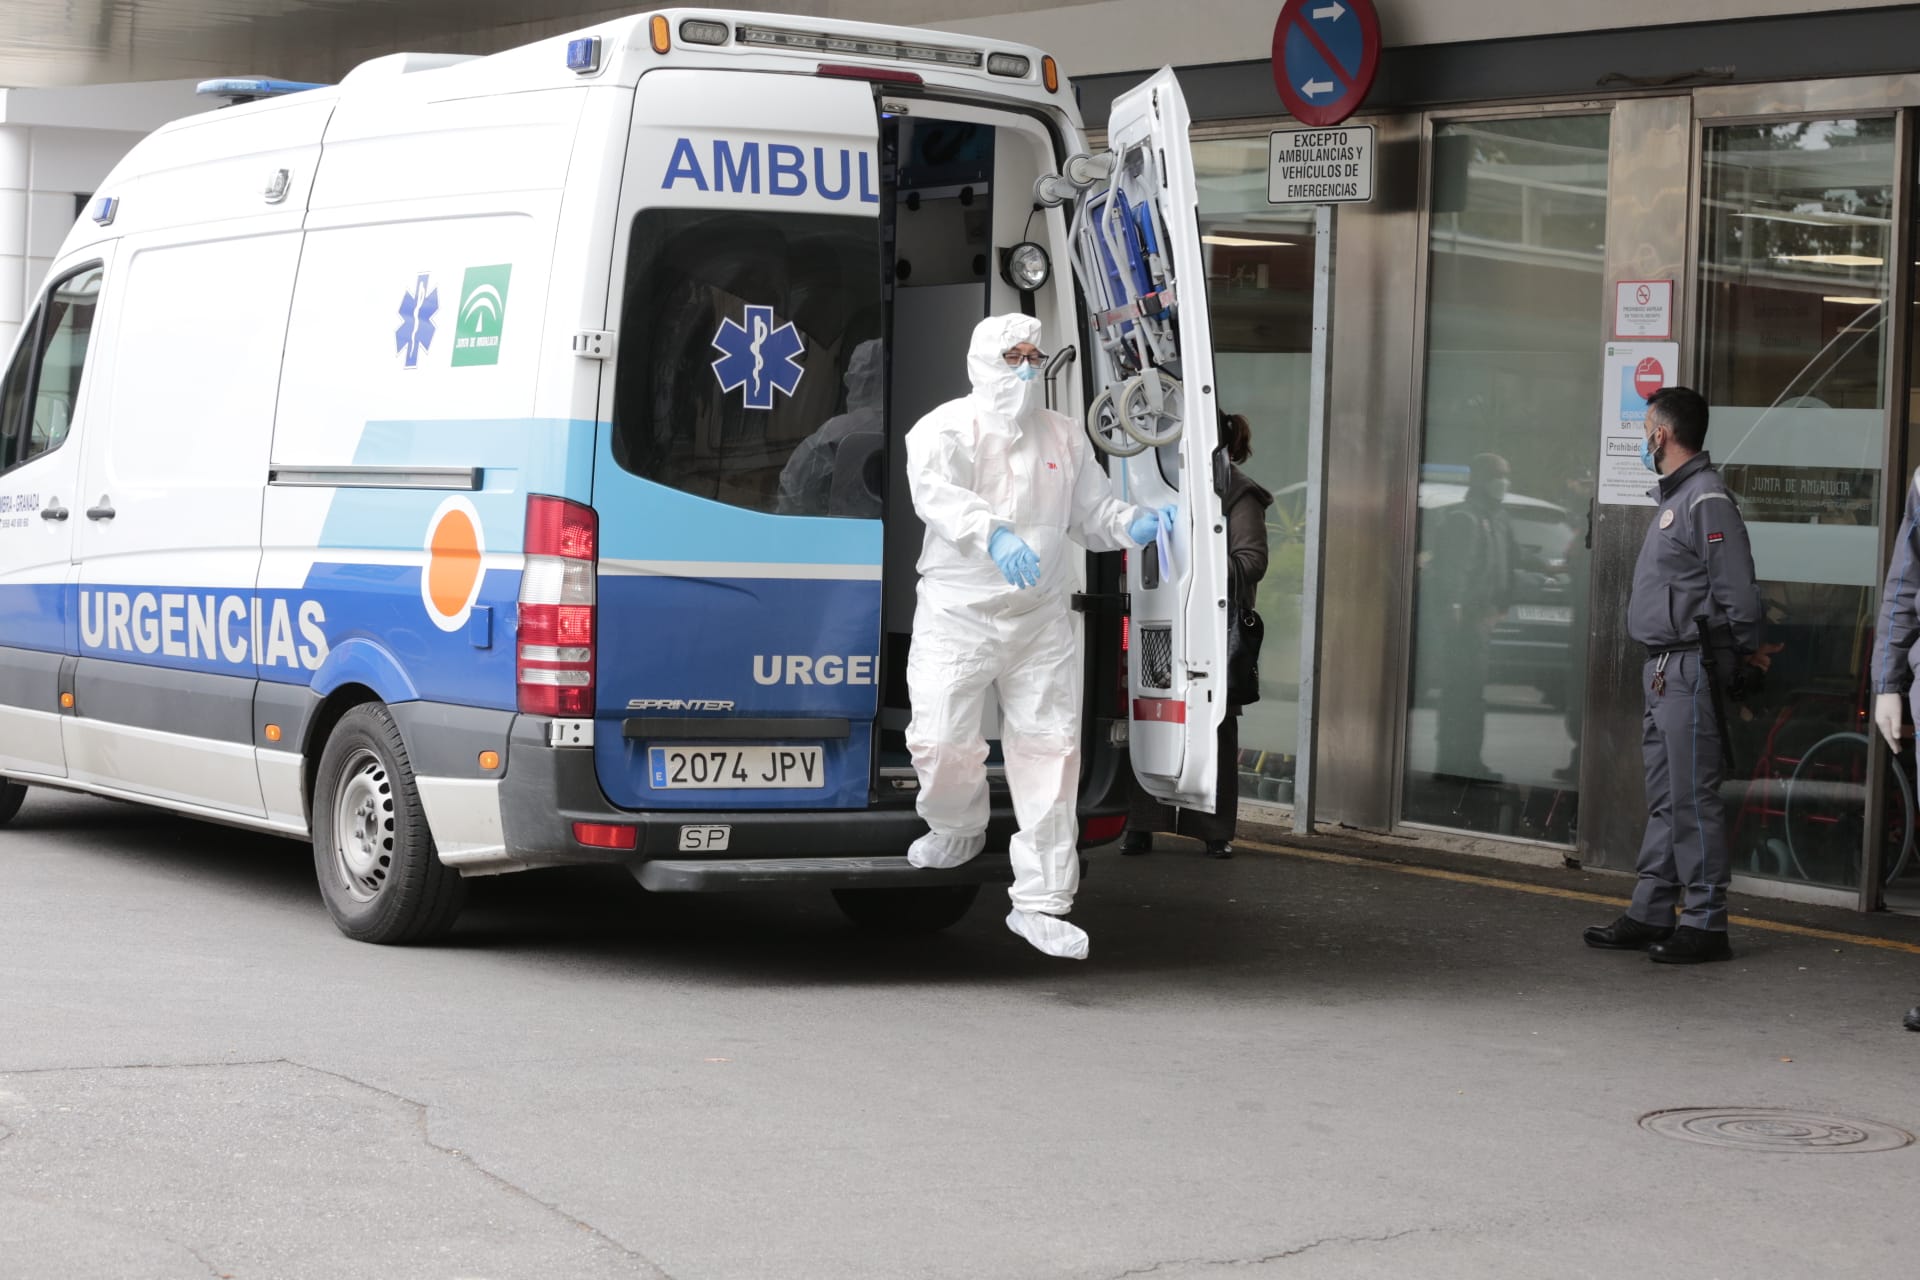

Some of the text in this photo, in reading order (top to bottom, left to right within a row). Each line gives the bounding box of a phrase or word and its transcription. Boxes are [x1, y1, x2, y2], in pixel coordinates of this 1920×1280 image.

[1294, 132, 1348, 147] EXCEPTO
[1279, 146, 1363, 163] AMBULANCIAS Y
[661, 137, 879, 204] AMBUL
[1282, 163, 1359, 179] VEHÍCULOS DE
[1288, 183, 1357, 198] EMERGENCIAS
[1621, 422, 1631, 430] sin
[1752, 476, 1781, 491] JUNTA
[1785, 478, 1797, 493] DE
[80, 591, 330, 671] URGENCIAS
[753, 655, 879, 685] URGE
[626, 698, 735, 711] SPRINTER
[656, 752, 816, 783] E 2074 JPV
[685, 830, 725, 848] SP
